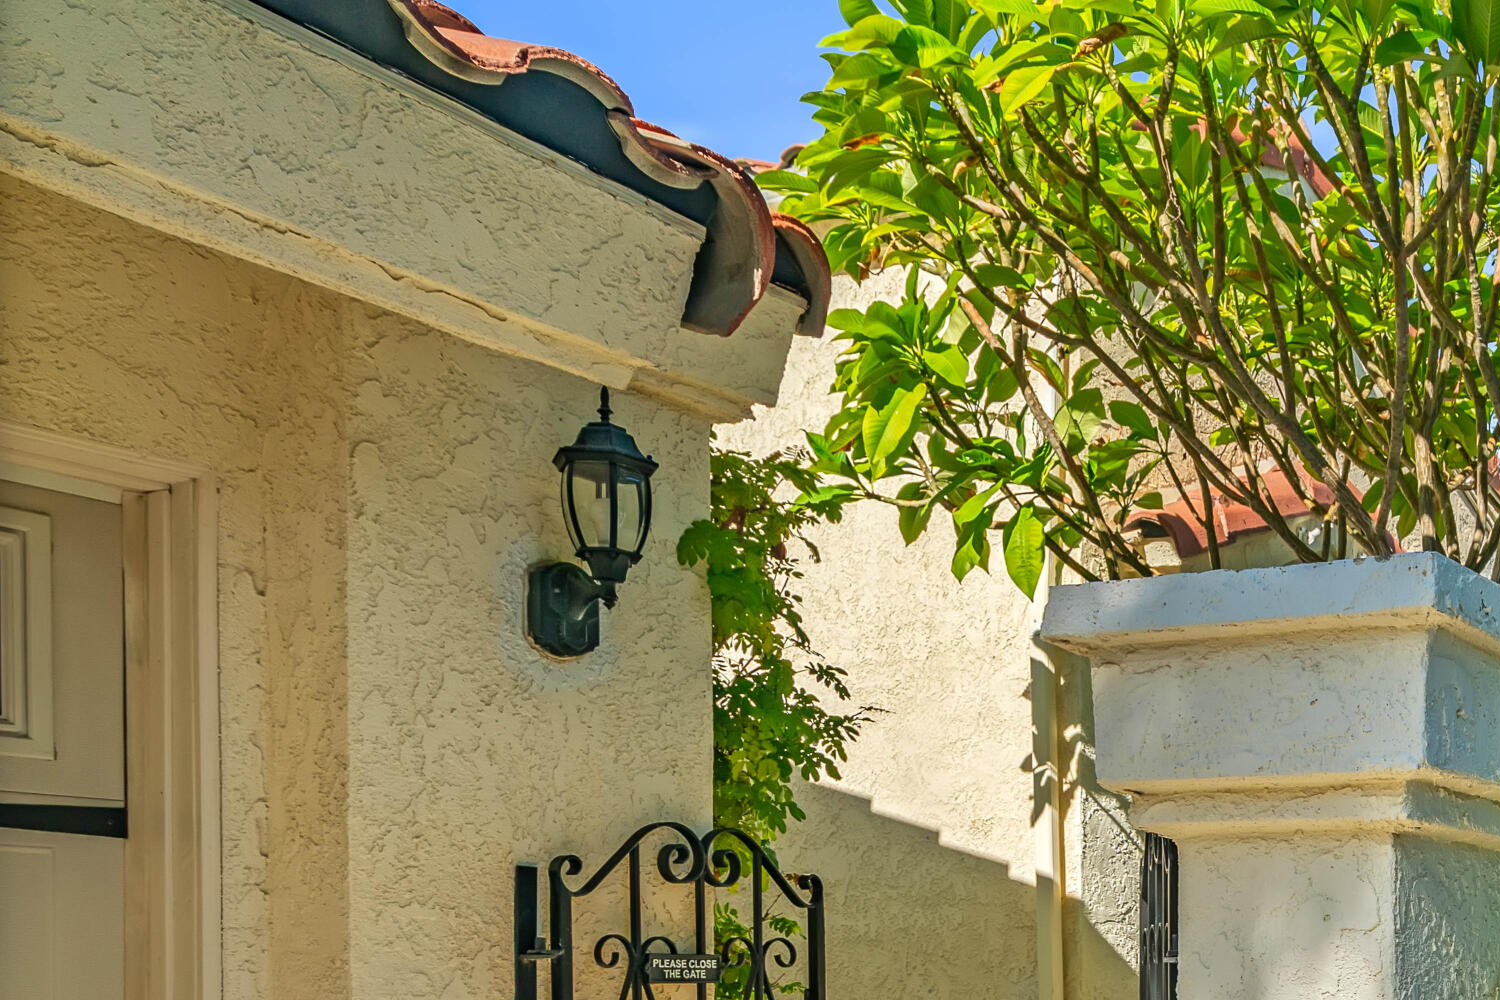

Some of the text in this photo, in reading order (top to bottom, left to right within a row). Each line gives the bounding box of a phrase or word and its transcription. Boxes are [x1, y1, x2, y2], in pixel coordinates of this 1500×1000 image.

[652, 959, 717, 968] PLEASE CLOSE
[664, 969, 706, 979] THE GATE
